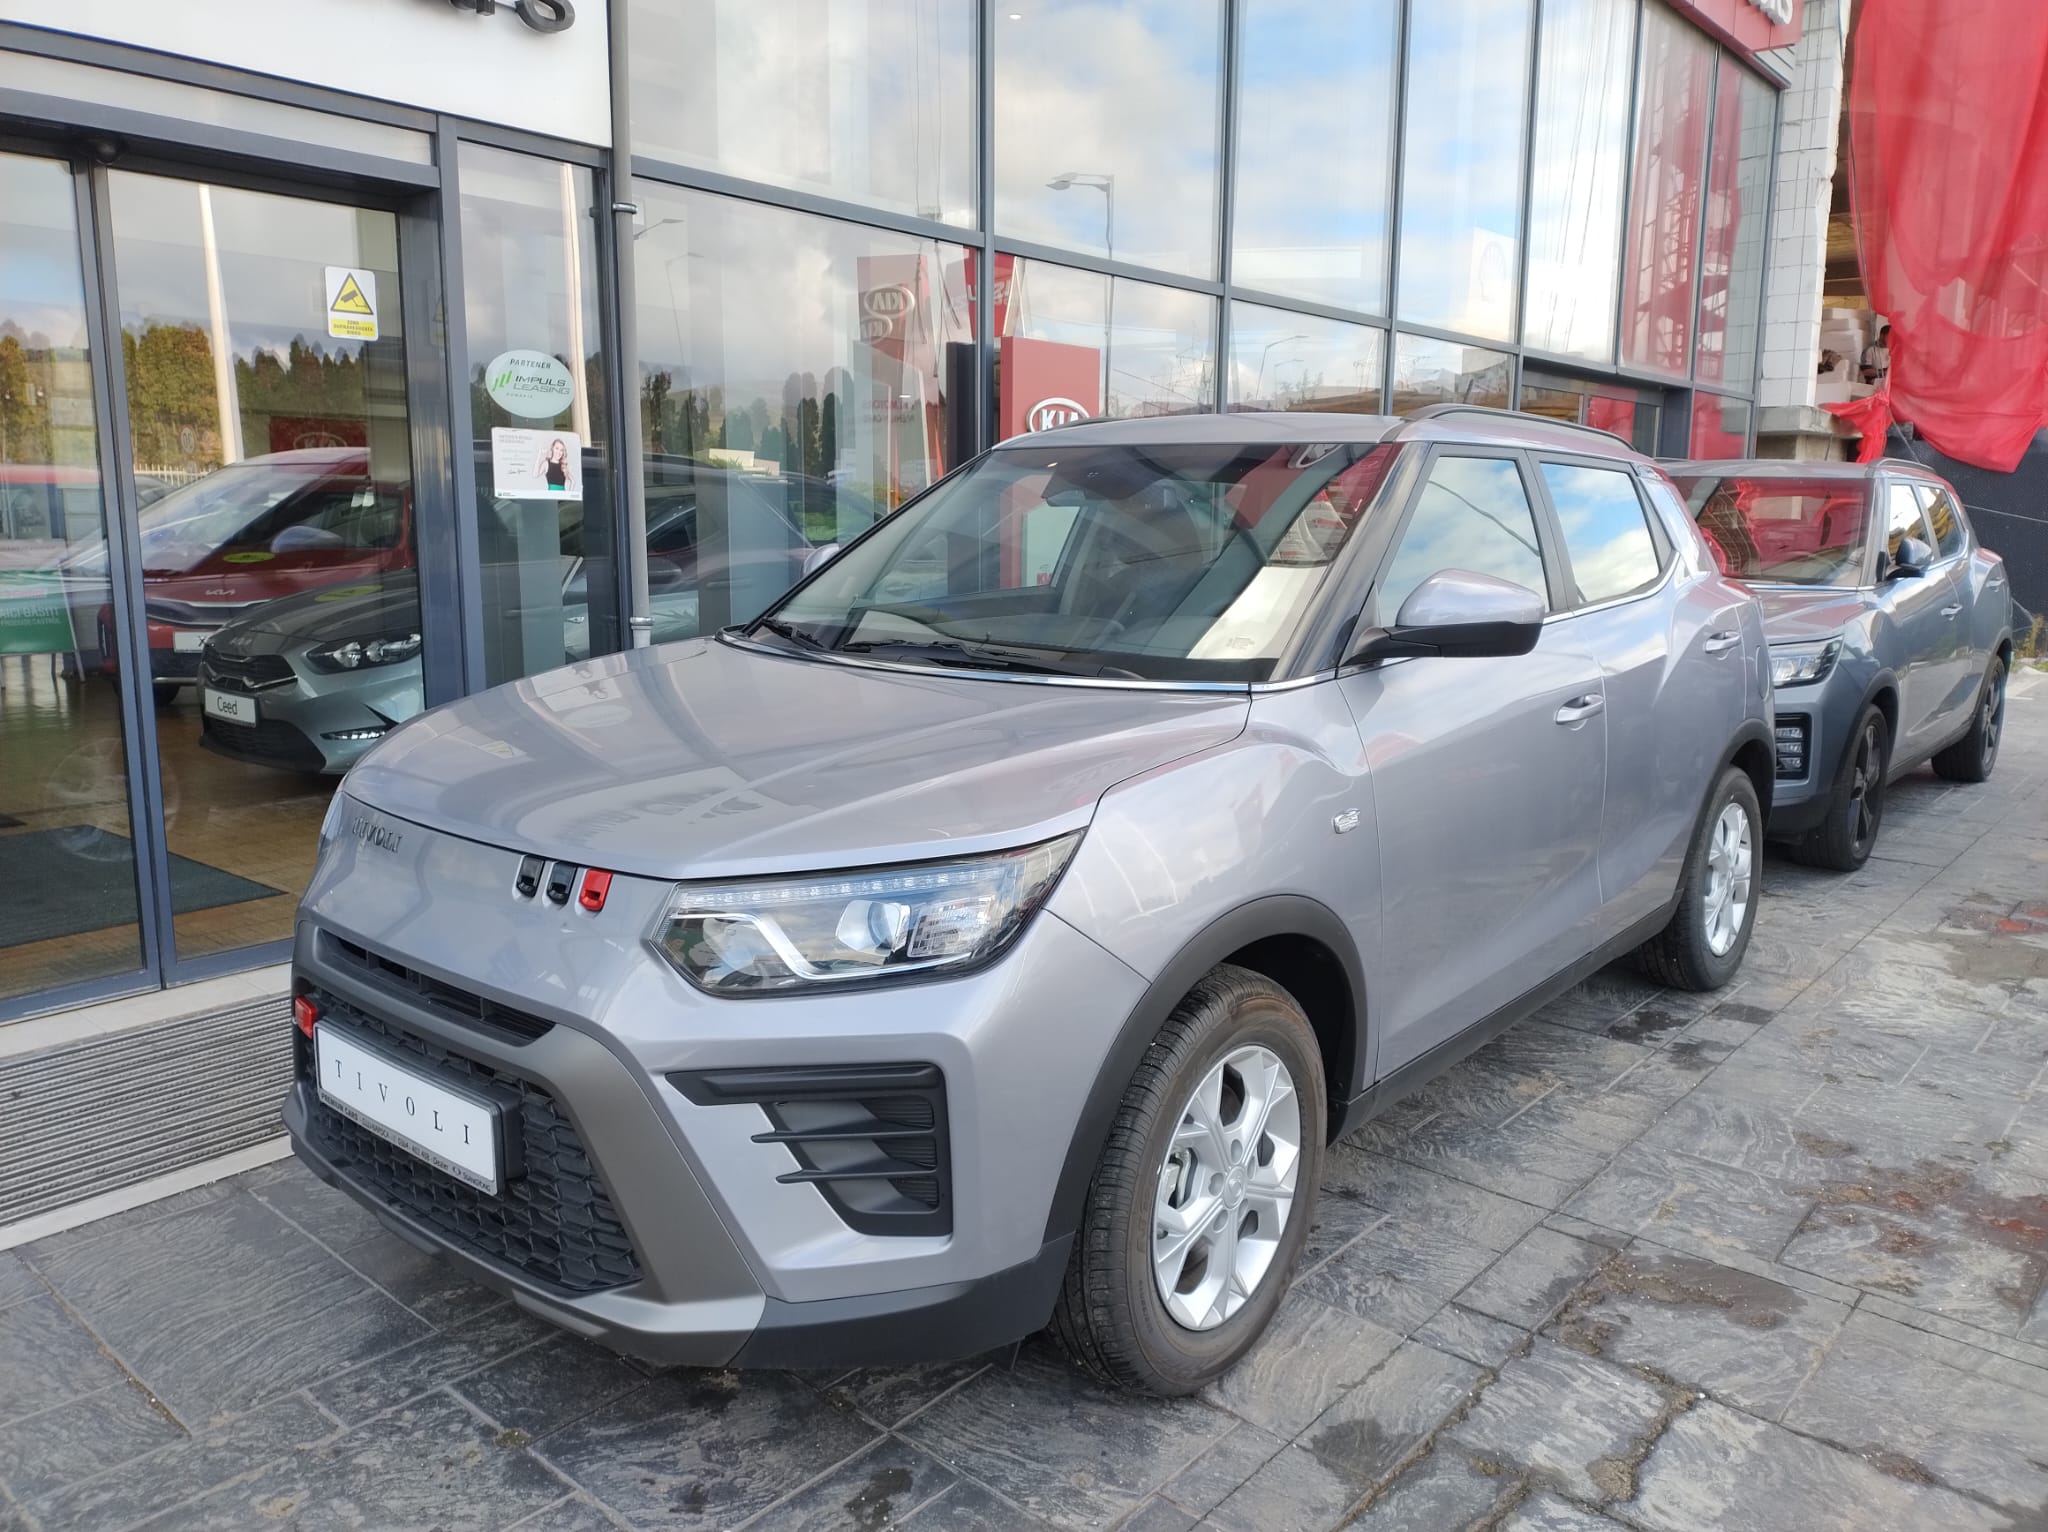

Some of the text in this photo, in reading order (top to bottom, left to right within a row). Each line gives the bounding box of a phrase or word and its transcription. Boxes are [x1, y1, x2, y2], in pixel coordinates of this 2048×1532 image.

[510, 358, 552, 370] PARTENER
[512, 383, 571, 396] LEASING
[515, 375, 568, 388] IMPULS
[1040, 408, 1080, 432] KIA
[216, 695, 239, 716] Ceed
[335, 1059, 471, 1145] TIVOLI
